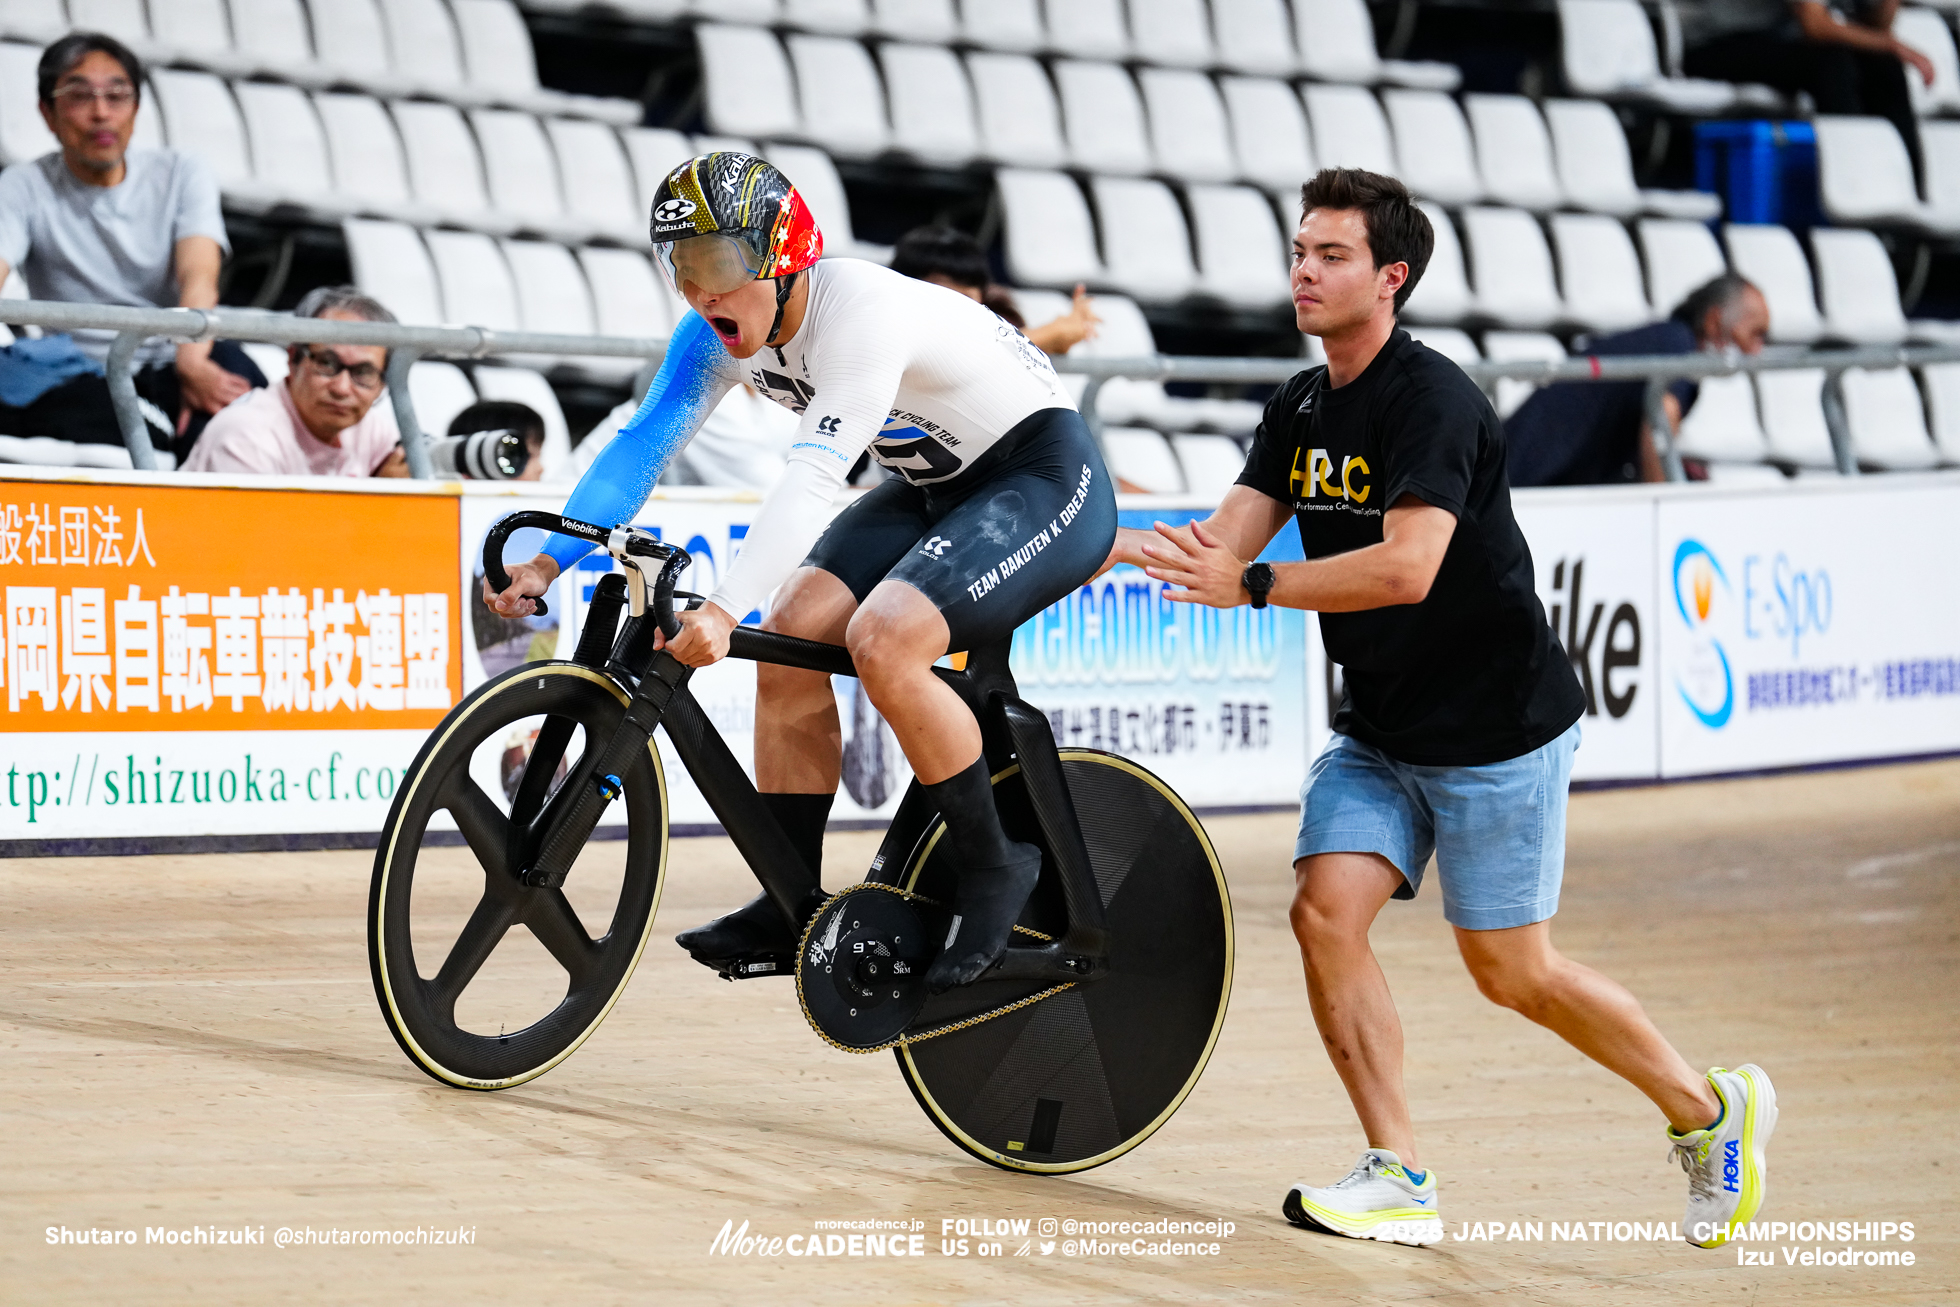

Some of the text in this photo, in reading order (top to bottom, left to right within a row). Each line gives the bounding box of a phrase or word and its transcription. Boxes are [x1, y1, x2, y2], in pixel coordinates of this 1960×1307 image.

[655, 220, 697, 233] Kabuto
[805, 222, 820, 257] JAP
[900, 412, 941, 432] CYCLING
[935, 429, 962, 448] TEAM
[561, 517, 600, 536] Velobike
[967, 464, 1093, 602] TEAM RAKUTEN K DREAMS
[0, 584, 452, 713] 岡県自転車競技連盟
[0, 751, 407, 823] tp://shizuoka-cf.co
[1723, 1139, 1739, 1193] HOKA
